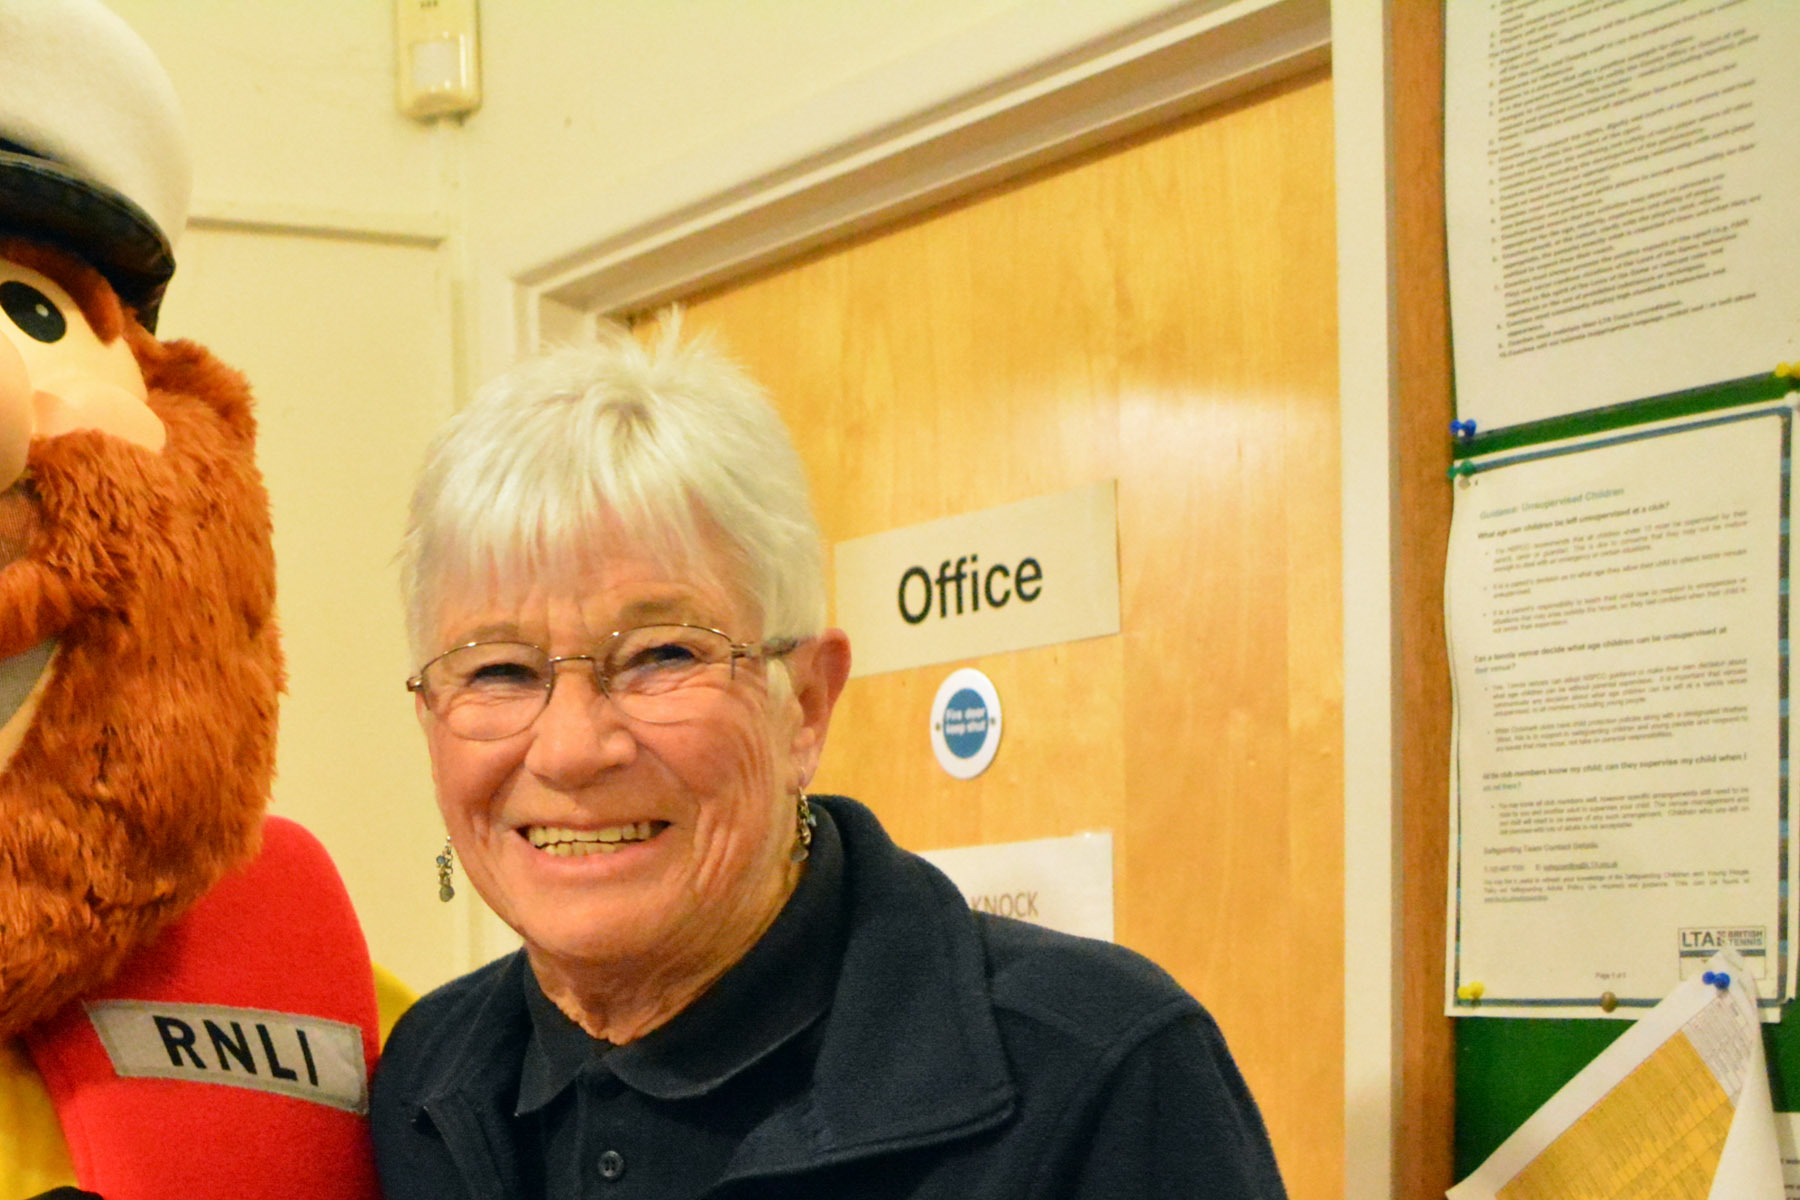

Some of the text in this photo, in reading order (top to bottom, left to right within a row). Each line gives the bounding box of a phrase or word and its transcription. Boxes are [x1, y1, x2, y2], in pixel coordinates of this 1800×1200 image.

[898, 554, 1043, 625] Office
[1695, 753, 1717, 764] child
[1718, 752, 1742, 762] when
[970, 891, 1040, 918] KNOCK
[1682, 930, 1763, 947] LTA BRITISH
[1729, 938, 1763, 946] TENNIS
[152, 1015, 319, 1087] RNLI
